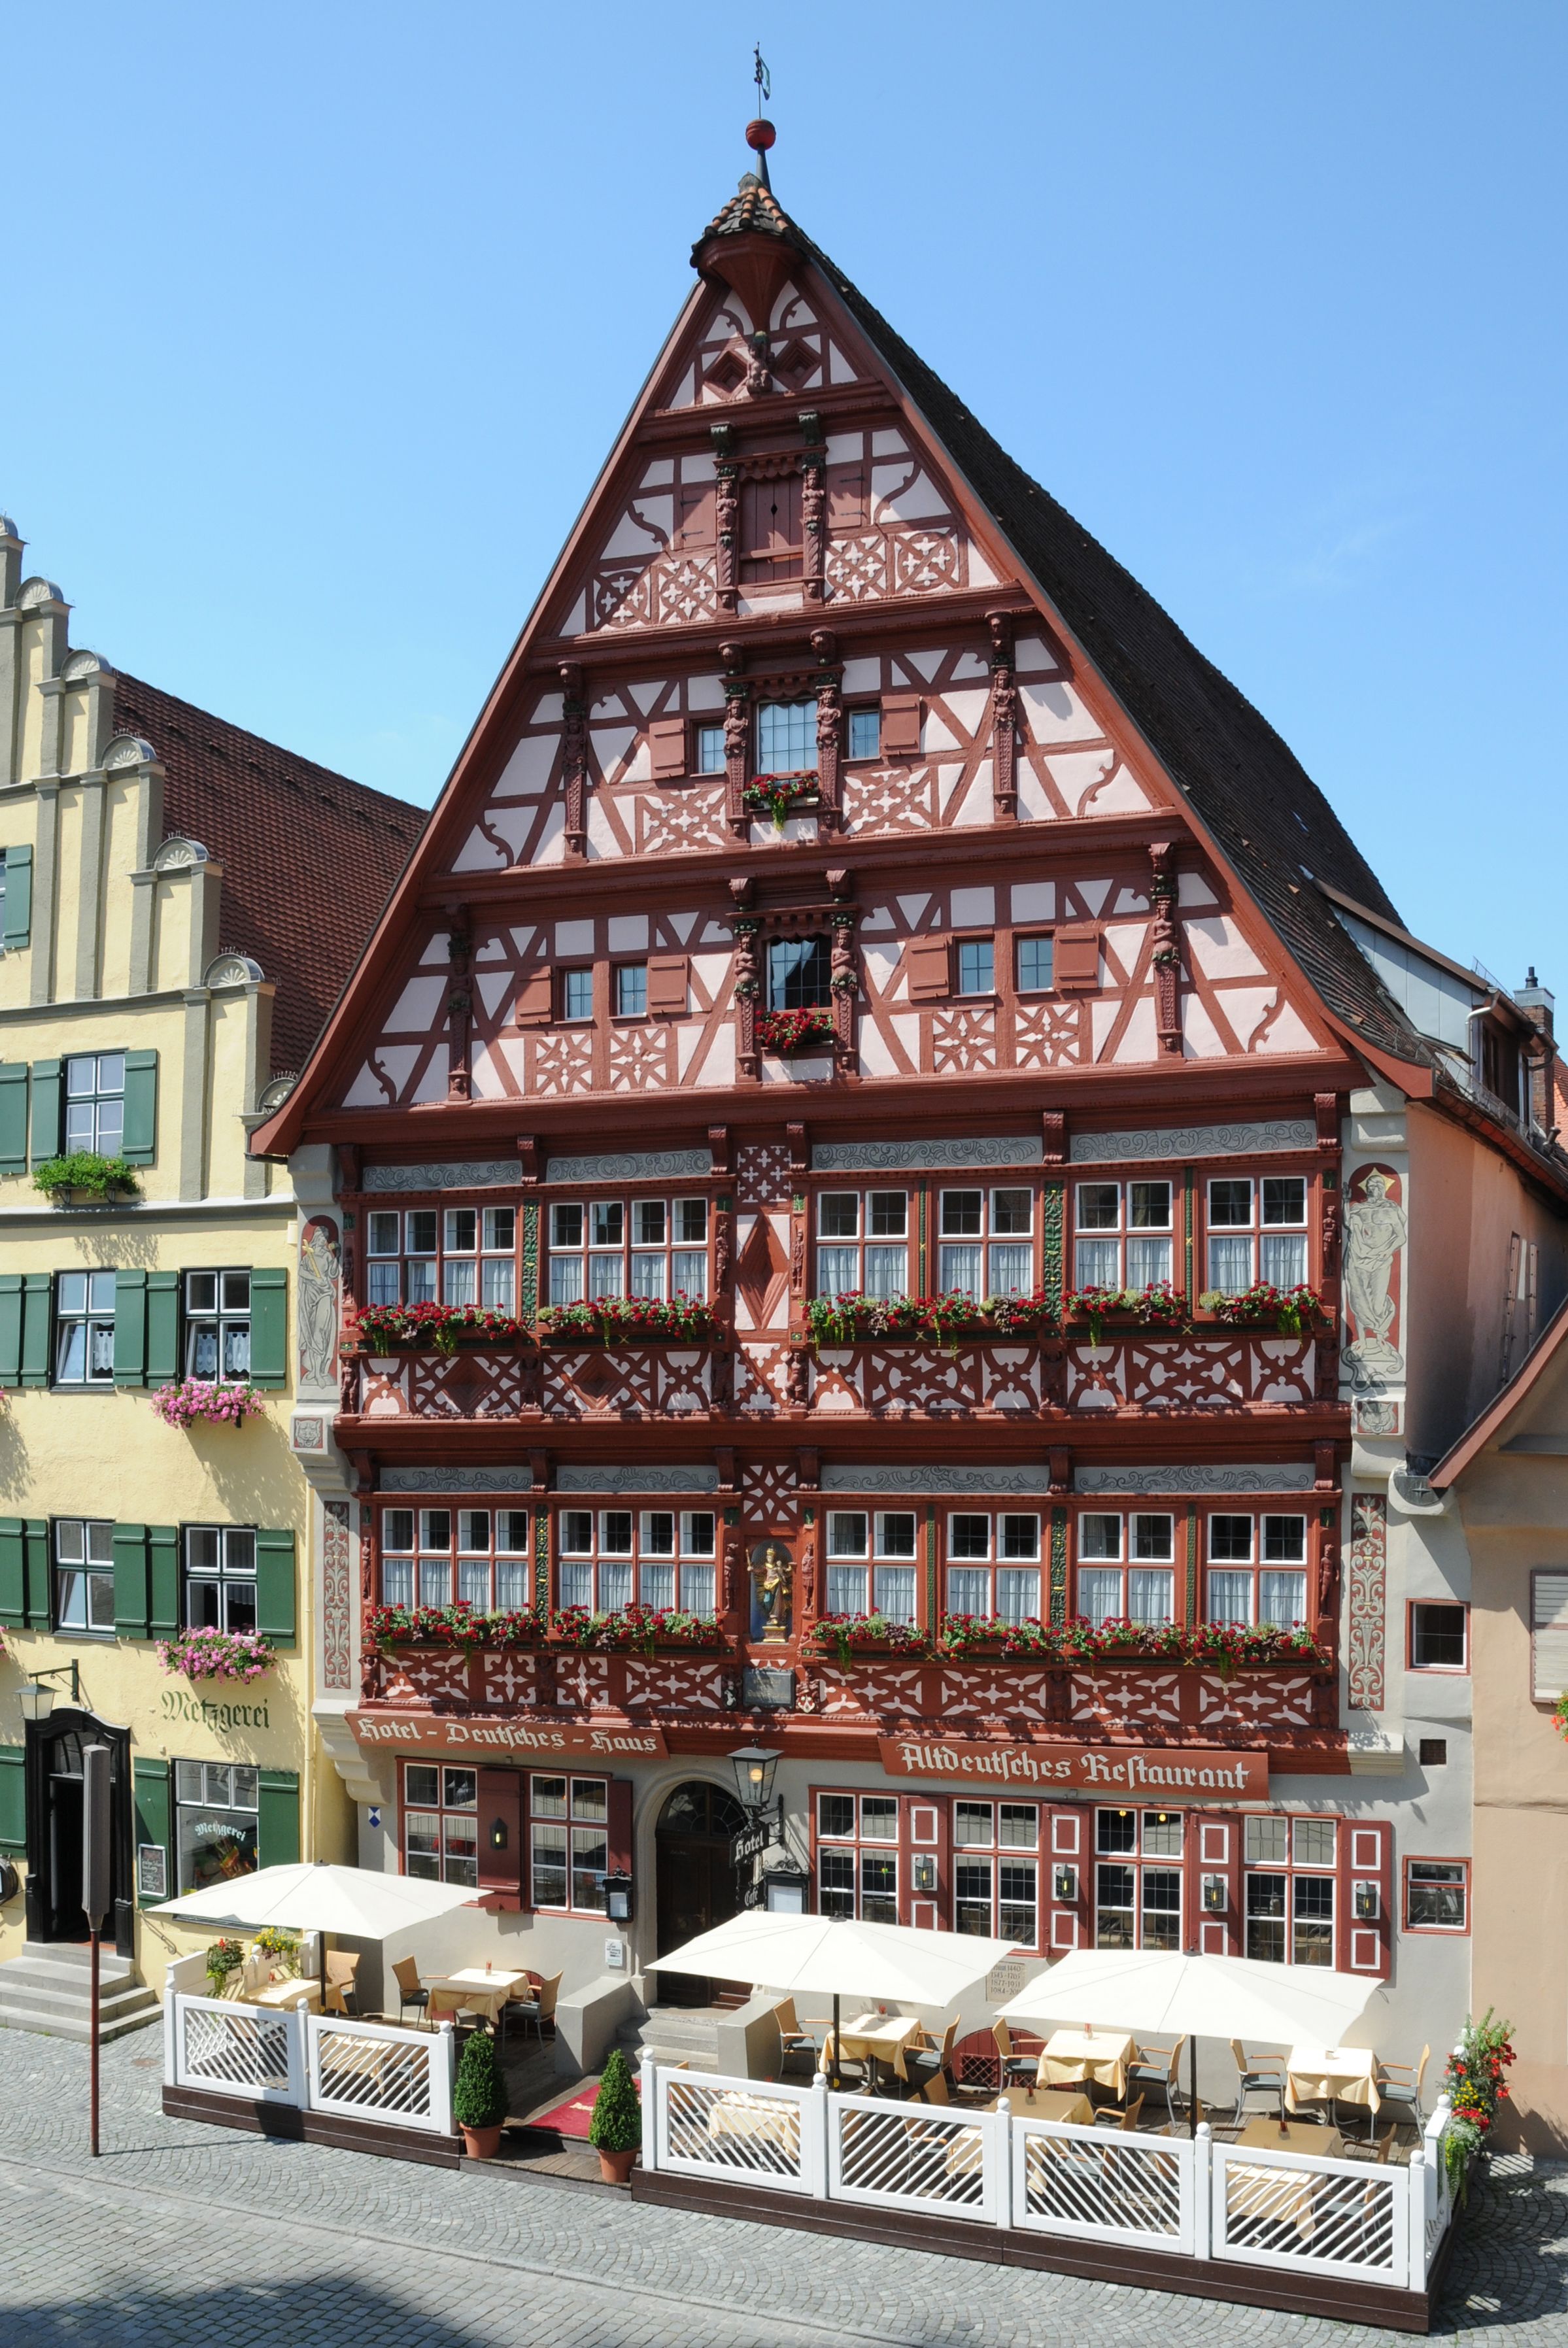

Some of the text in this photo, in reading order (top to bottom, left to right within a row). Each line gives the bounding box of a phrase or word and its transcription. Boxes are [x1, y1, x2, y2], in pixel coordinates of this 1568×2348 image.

[161, 1690, 269, 1733] Metzgerei
[357, 1716, 422, 1743] Hotel
[445, 1722, 566, 1751] Deutsches
[590, 1728, 659, 1754] Haus
[895, 1741, 1252, 1790] Altdeutsches Restaurant
[194, 1821, 247, 1842] Metzgerei
[734, 1829, 764, 1863] Hotel
